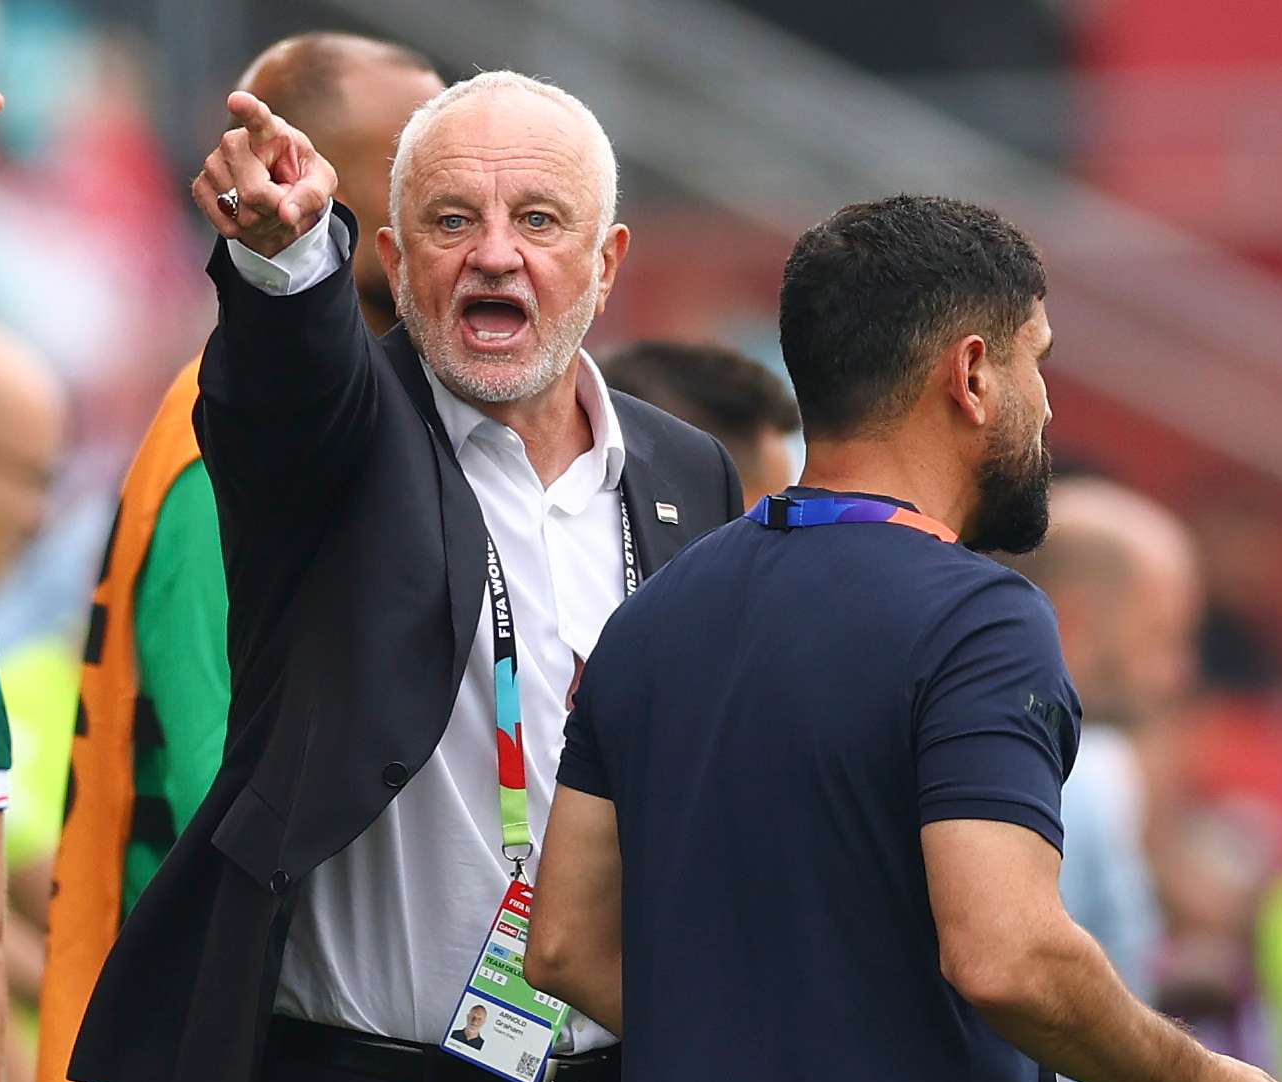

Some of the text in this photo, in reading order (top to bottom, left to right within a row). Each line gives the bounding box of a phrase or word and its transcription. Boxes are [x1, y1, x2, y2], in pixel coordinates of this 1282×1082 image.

[621, 502, 637, 596] WORLD CU
[496, 597, 511, 639] FIFA
[499, 1011, 528, 1027] ARNOLD
